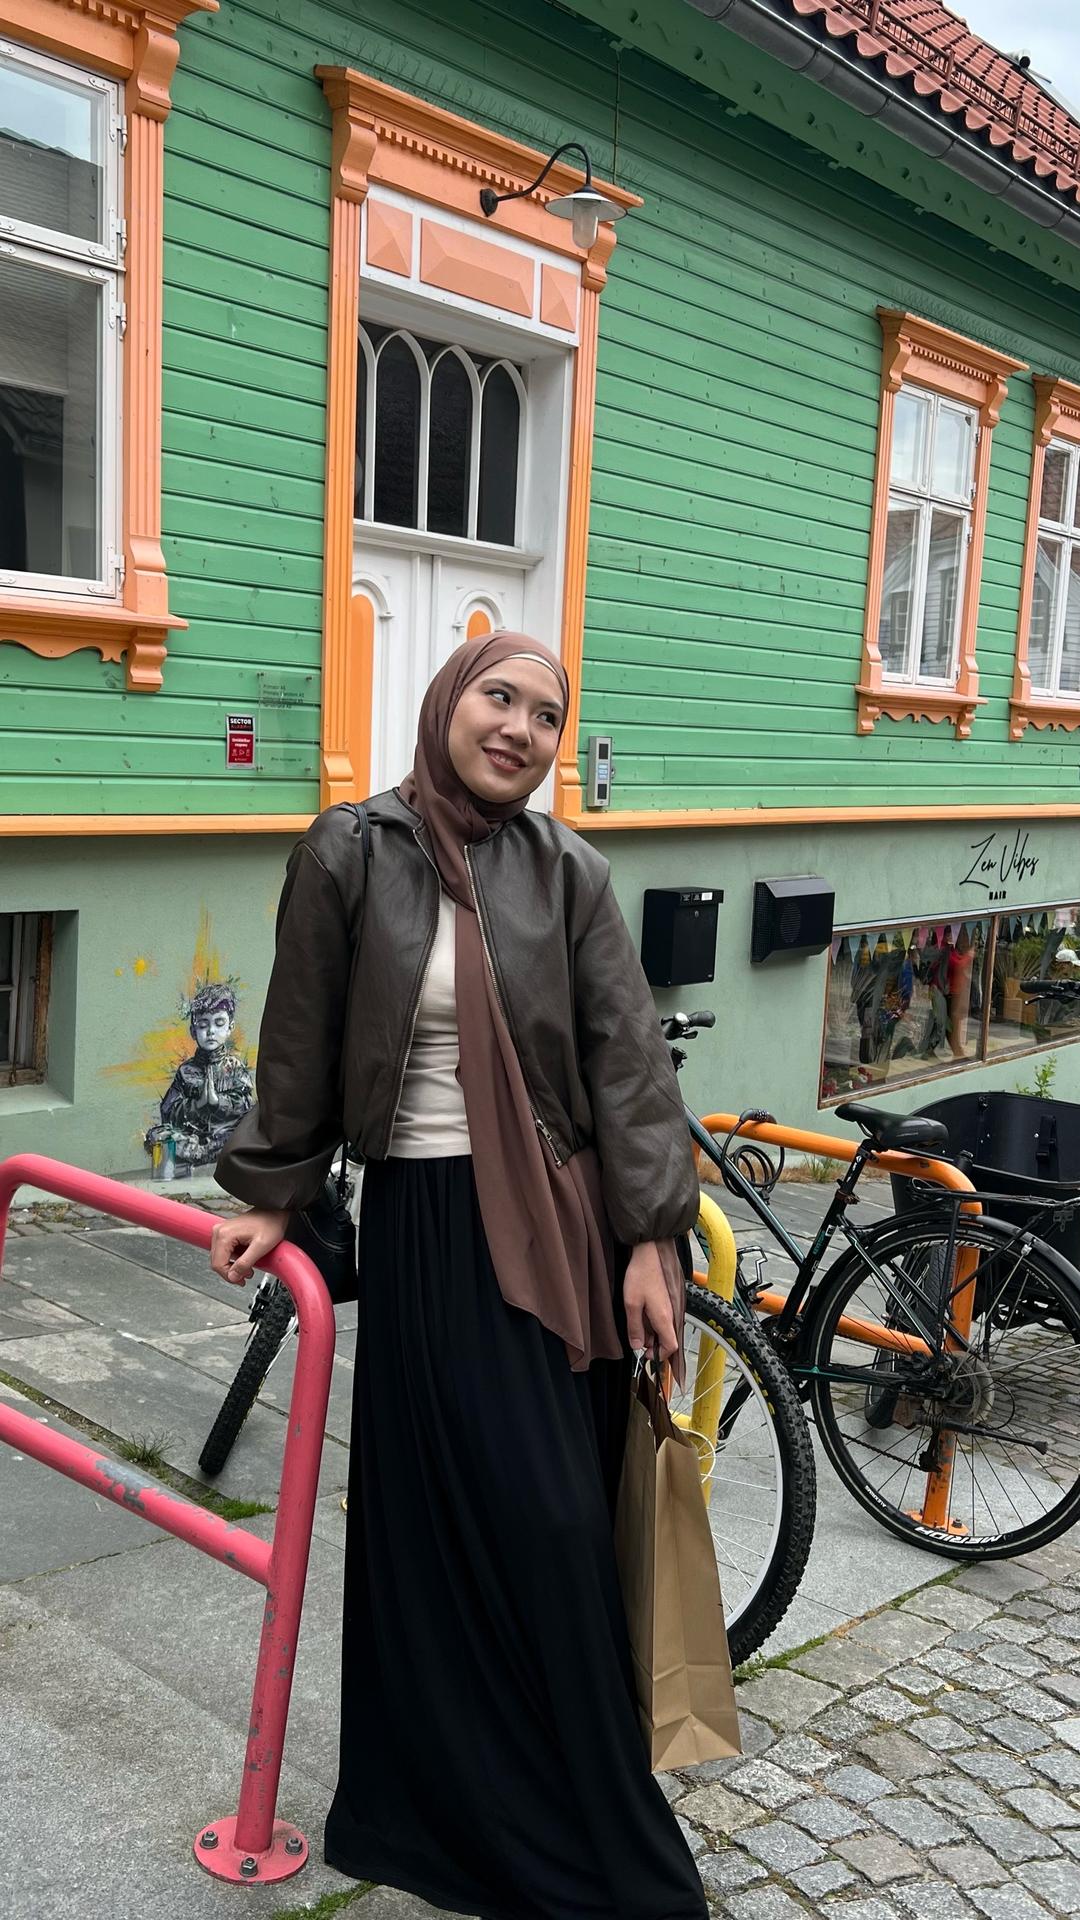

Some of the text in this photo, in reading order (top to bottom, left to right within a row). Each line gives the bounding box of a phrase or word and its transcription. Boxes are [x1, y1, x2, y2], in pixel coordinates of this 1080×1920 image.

[959, 828, 1039, 888] Zen Vibes
[989, 891, 1006, 900] HAIR
[707, 1318, 776, 1416] MAXXIS
[914, 1525, 1003, 1545] MERIDA
